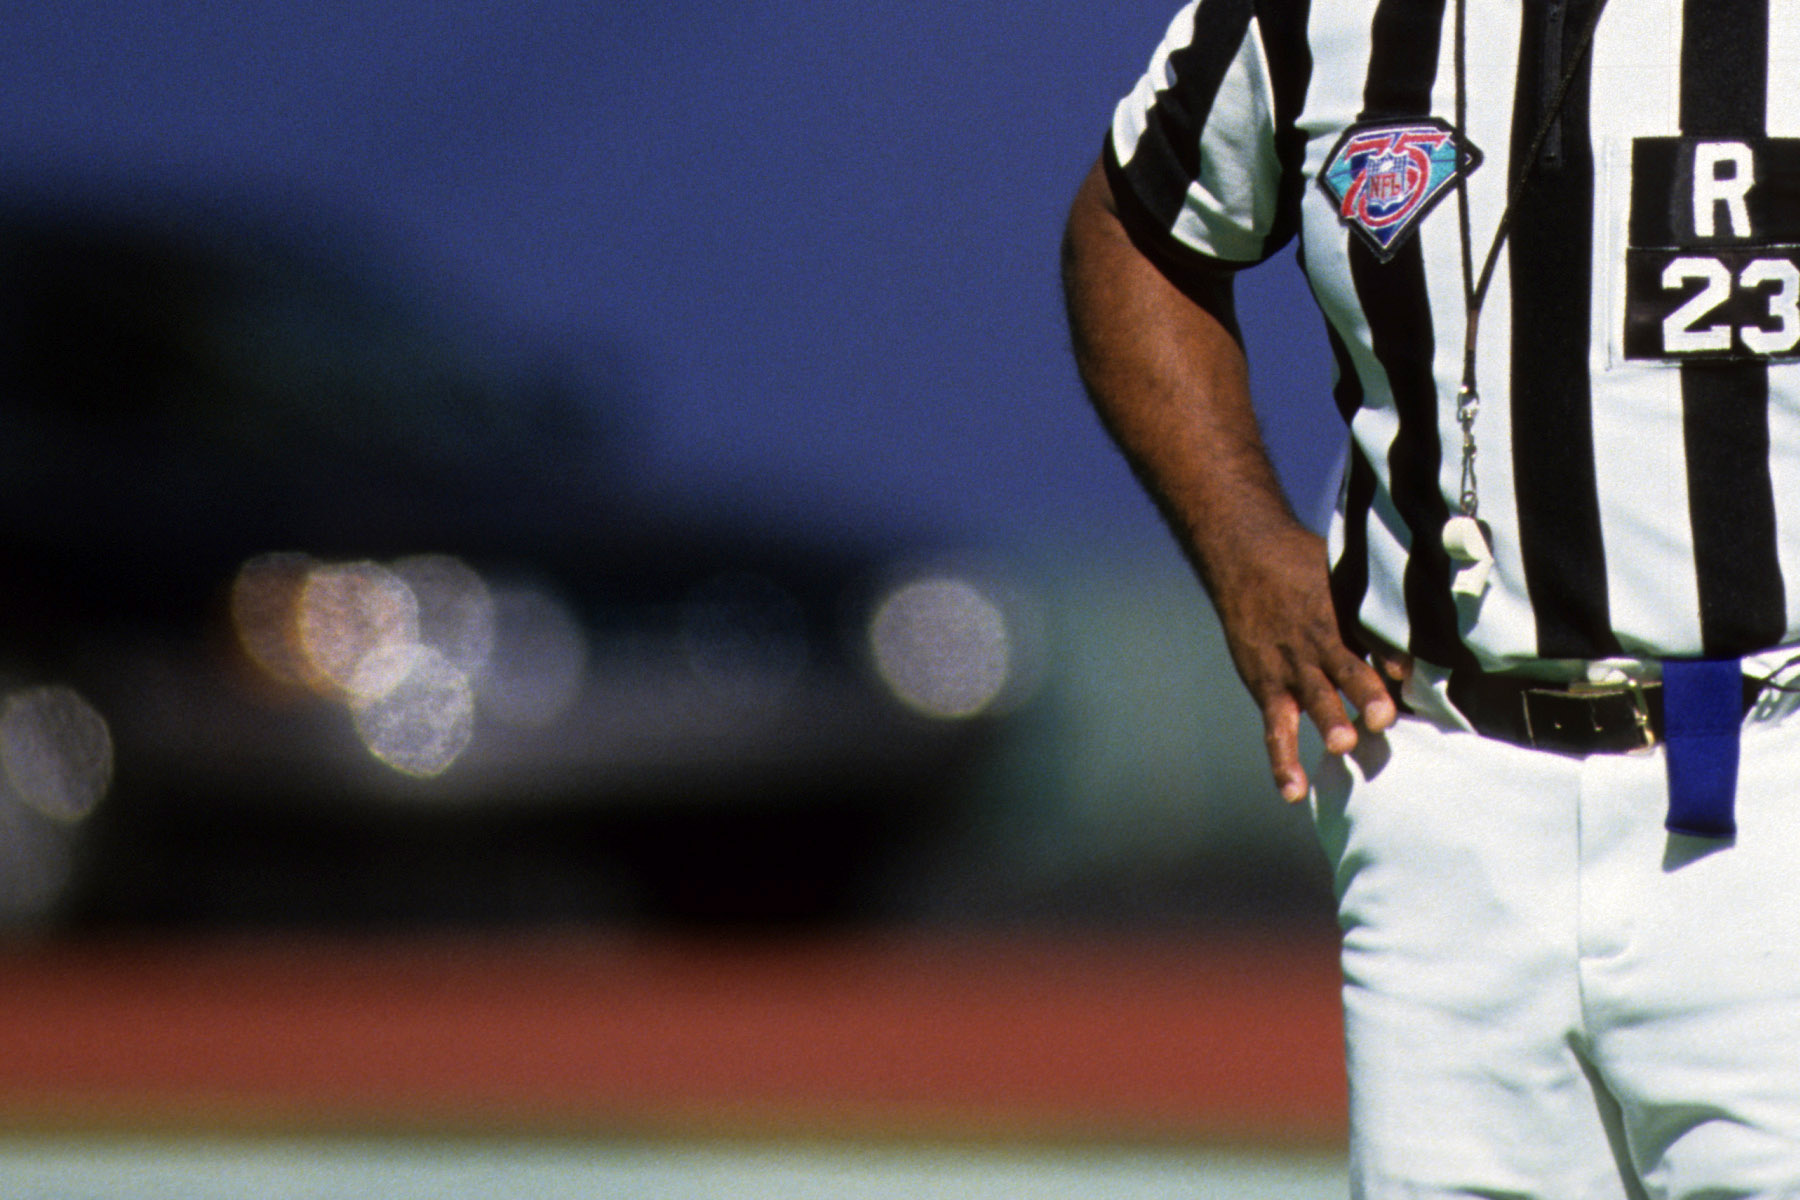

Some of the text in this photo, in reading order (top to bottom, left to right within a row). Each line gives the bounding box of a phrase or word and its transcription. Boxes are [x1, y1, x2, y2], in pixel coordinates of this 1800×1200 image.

[1341, 131, 1452, 229] 75
[1369, 173, 1403, 200] NFL
[1692, 141, 1756, 238] R
